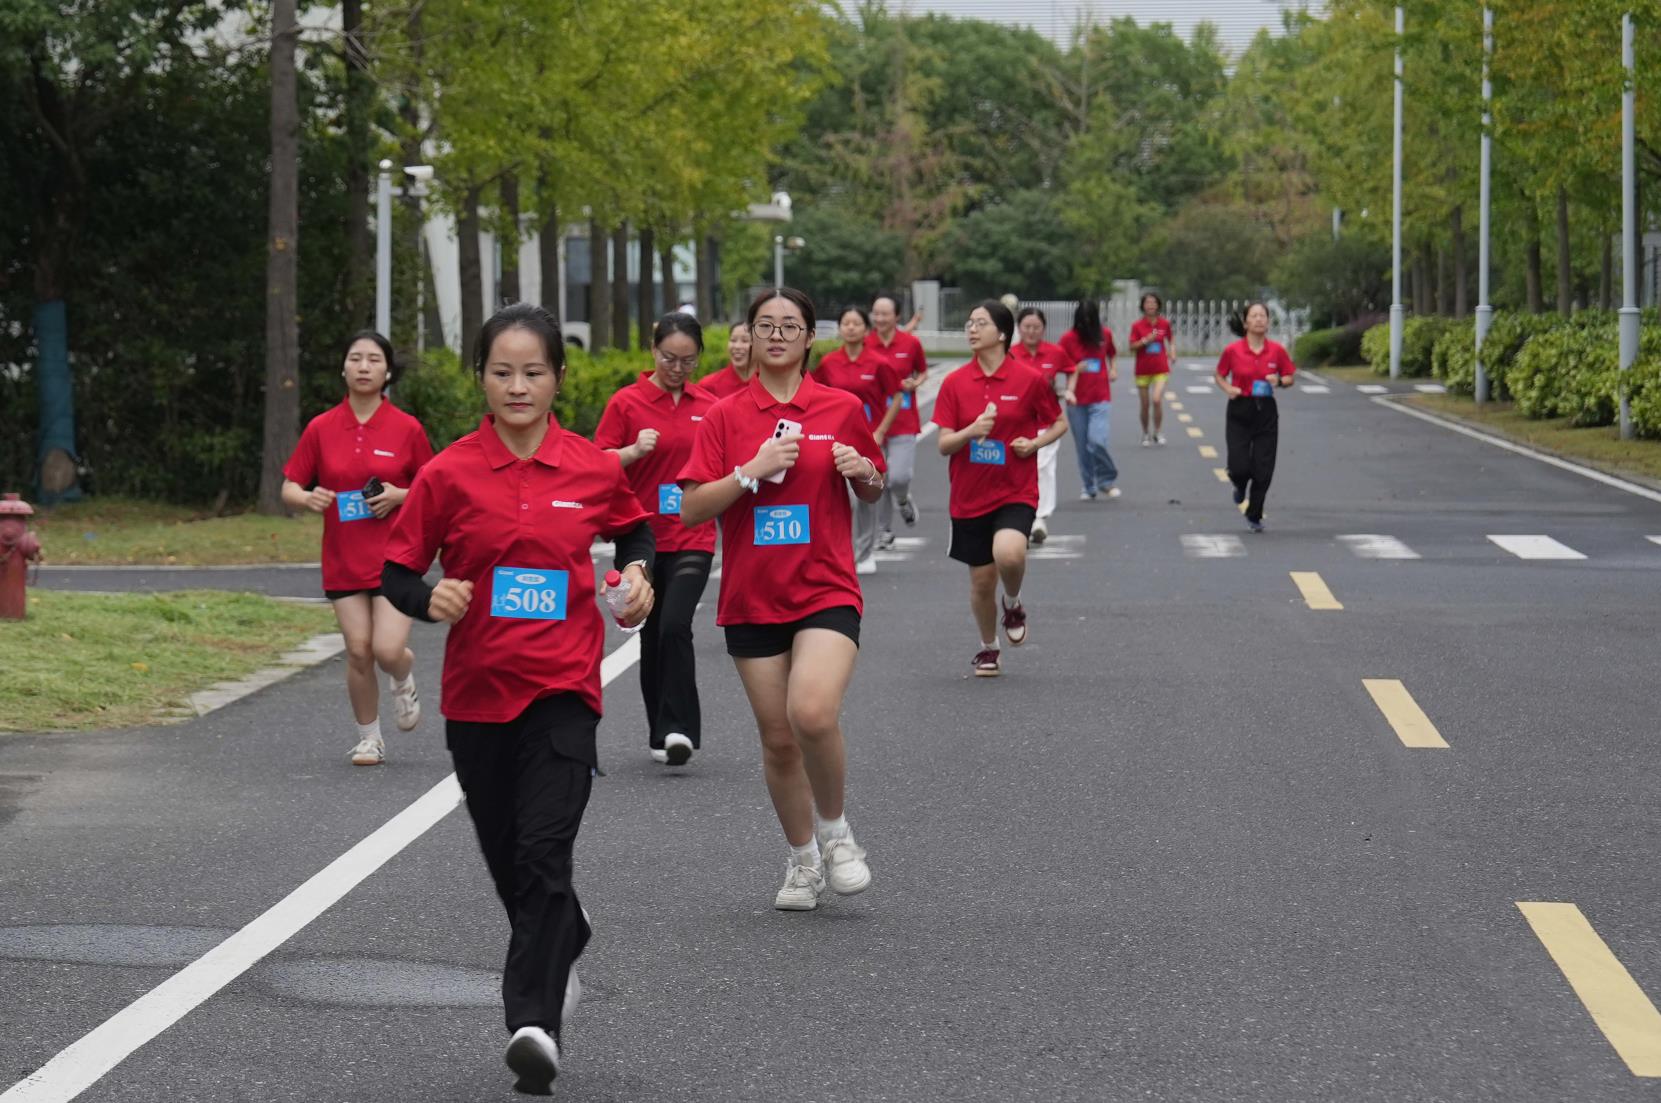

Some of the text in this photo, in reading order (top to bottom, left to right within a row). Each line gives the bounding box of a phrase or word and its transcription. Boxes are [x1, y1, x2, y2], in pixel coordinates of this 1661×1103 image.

[976, 448, 1001, 461] 509
[764, 520, 801, 540] 510
[505, 587, 557, 613] 508
